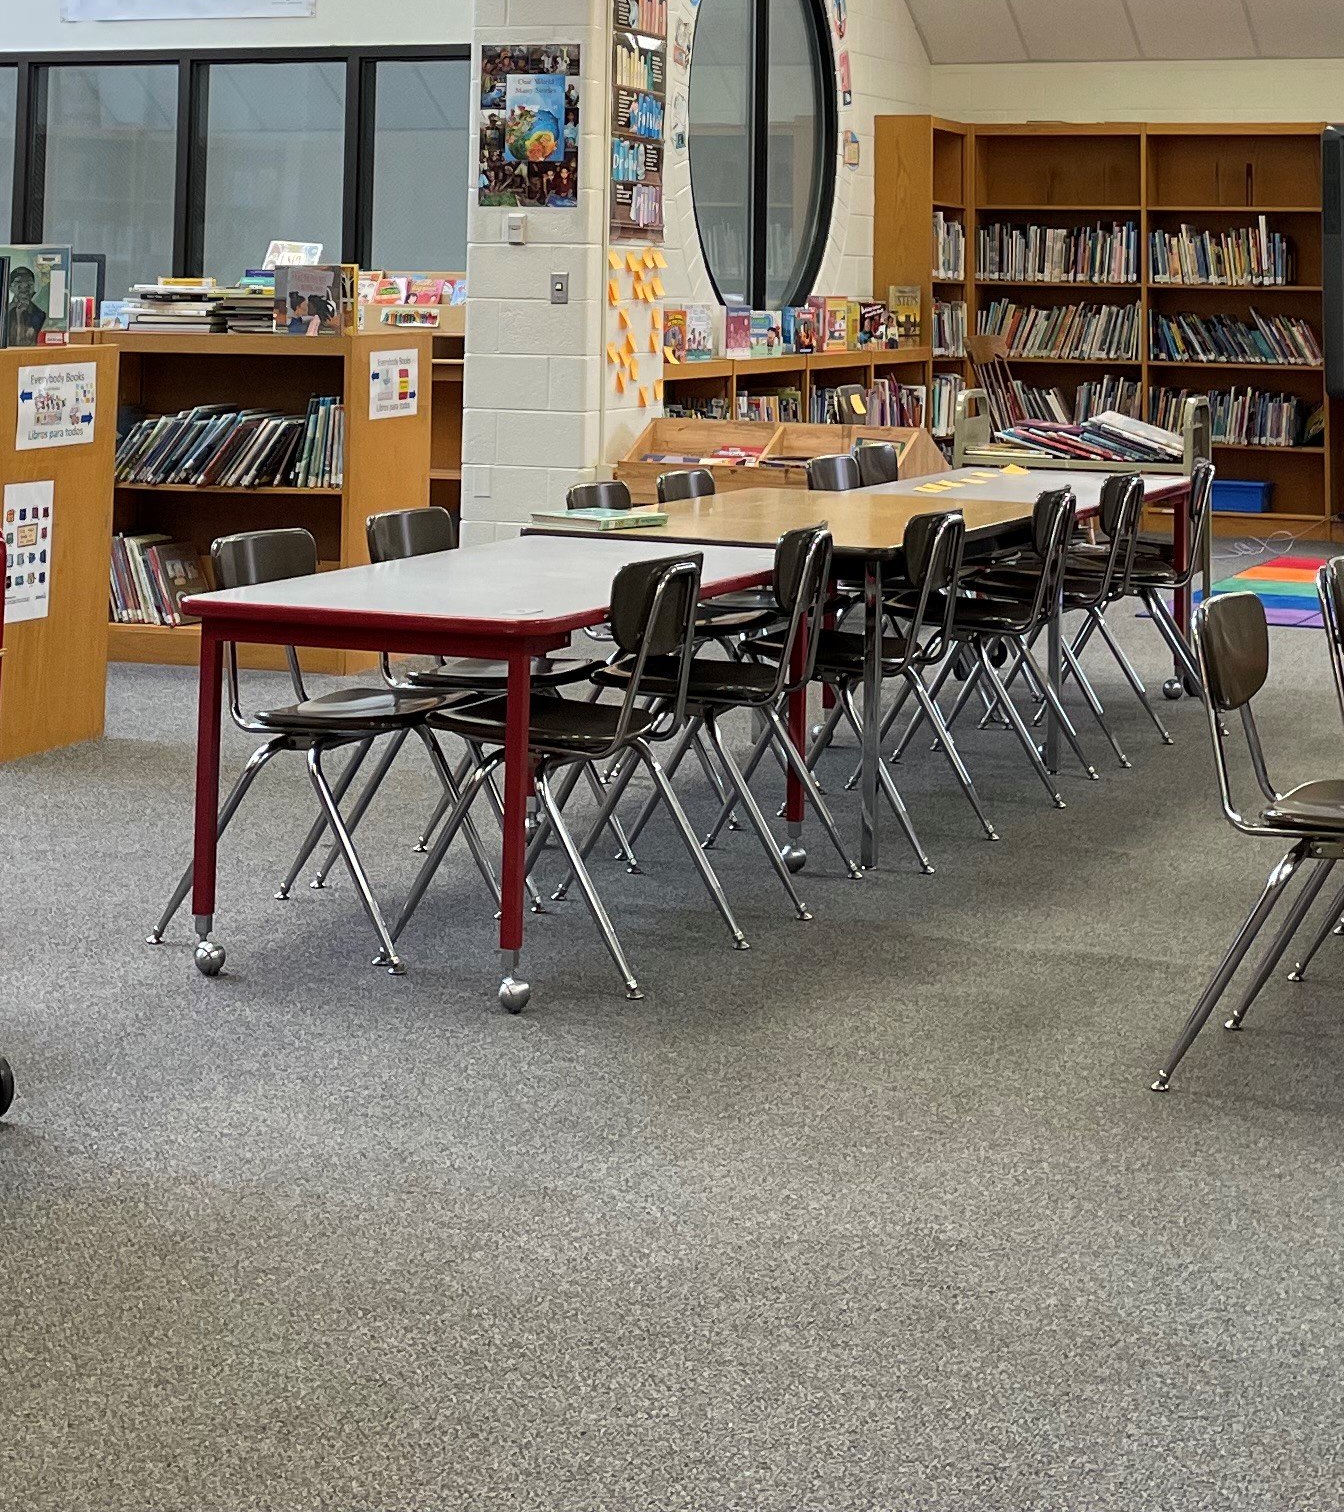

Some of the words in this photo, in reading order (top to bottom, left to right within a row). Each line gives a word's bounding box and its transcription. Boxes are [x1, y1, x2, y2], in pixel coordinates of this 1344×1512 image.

[30, 372, 65, 385] Everybody
[65, 371, 85, 383] Books
[28, 429, 48, 441] Libros
[49, 429, 64, 440] para
[65, 426, 84, 437] todos
